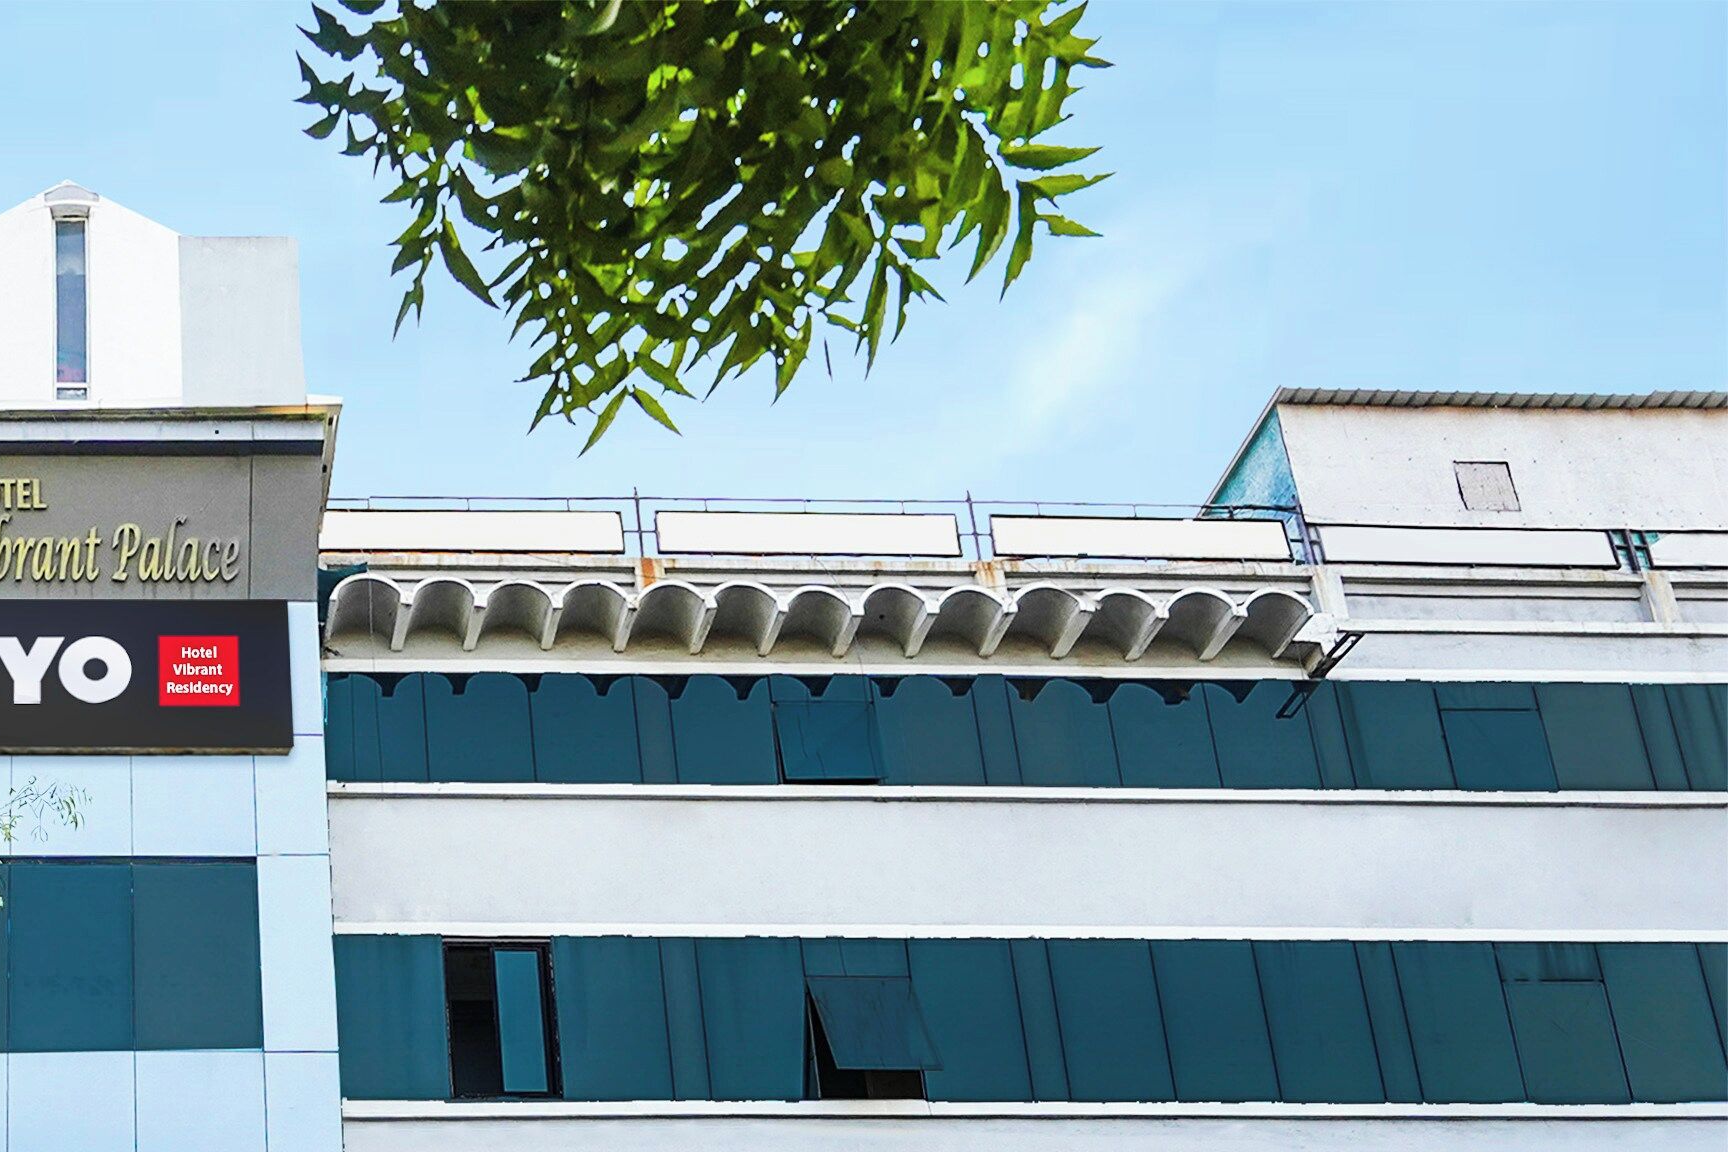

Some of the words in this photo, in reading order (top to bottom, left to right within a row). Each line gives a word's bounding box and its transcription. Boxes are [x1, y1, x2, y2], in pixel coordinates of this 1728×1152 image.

[112, 514, 241, 583] Palace
[181, 645, 217, 659] Hotel
[173, 662, 223, 676] Vibrant
[166, 680, 234, 696] Residency
